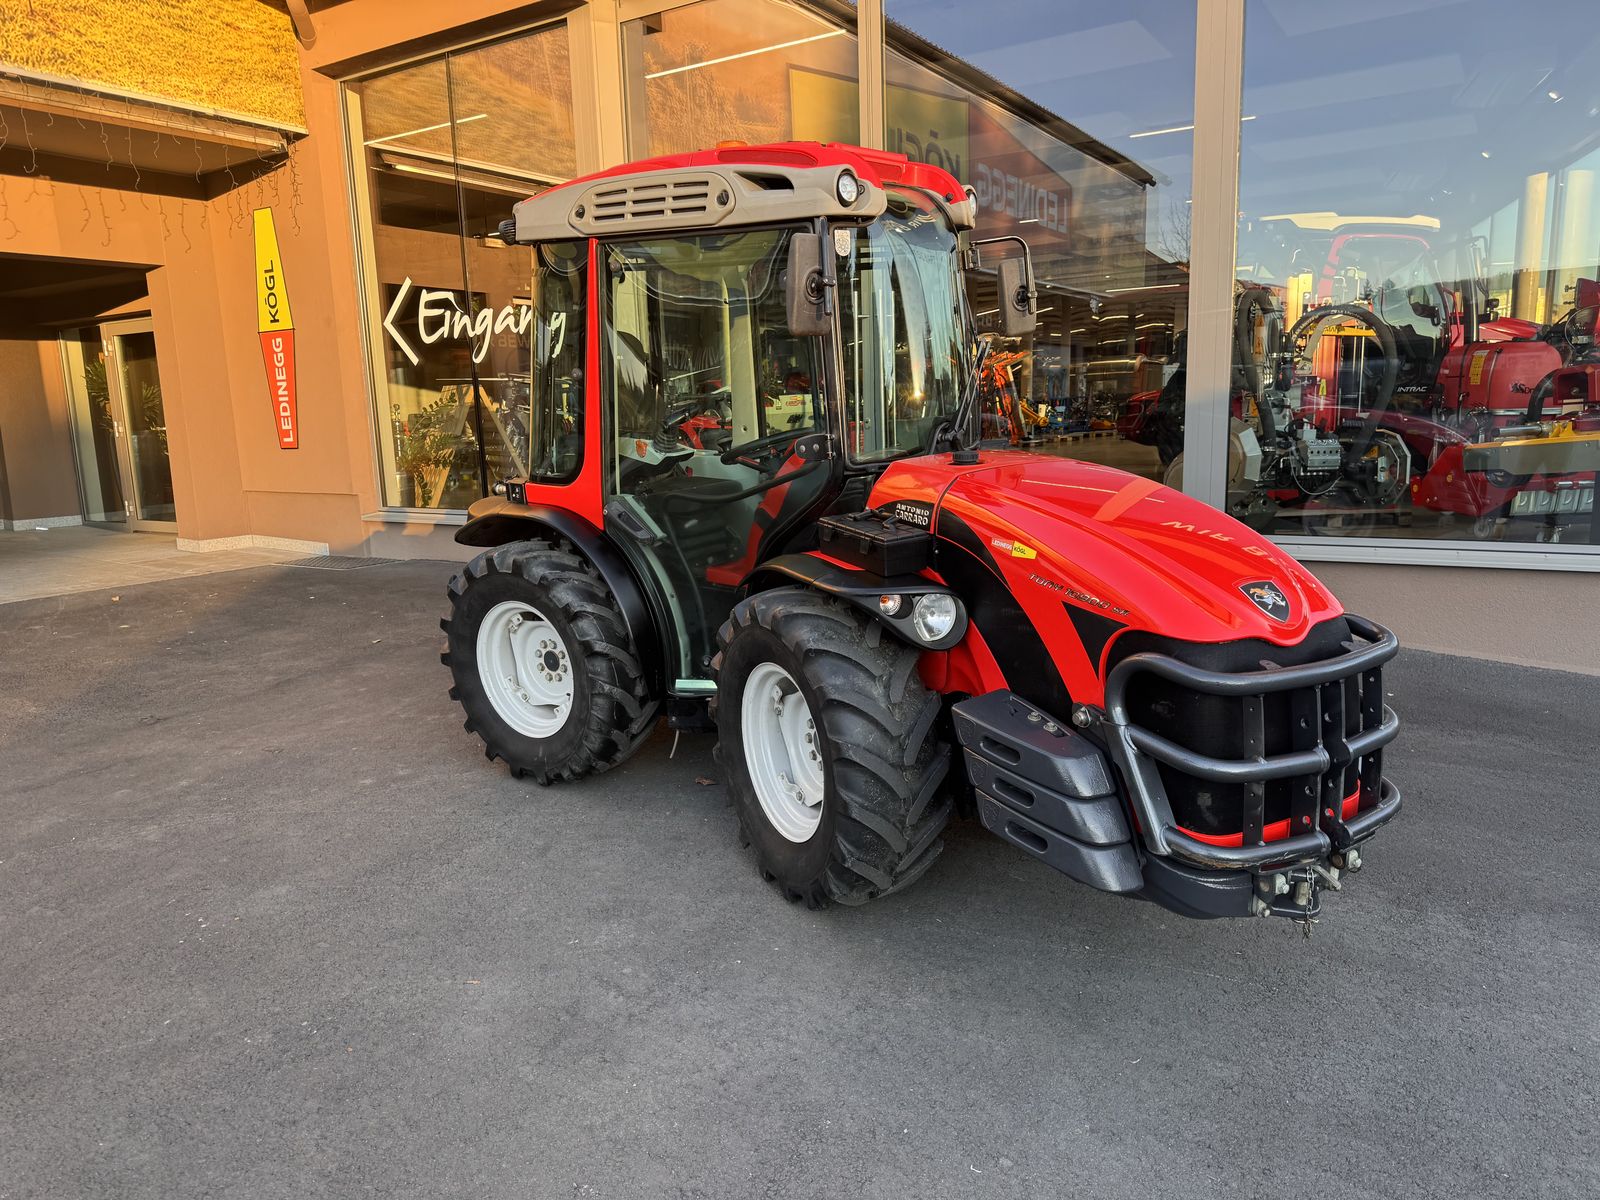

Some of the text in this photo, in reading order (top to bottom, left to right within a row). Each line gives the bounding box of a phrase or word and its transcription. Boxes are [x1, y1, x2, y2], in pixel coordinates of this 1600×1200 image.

[418, 288, 567, 364] Eingang
[264, 259, 294, 442] LEDINEGG KÖGL
[895, 509, 929, 526] CARRARO
[896, 503, 930, 516] ANTONIO
[1028, 573, 1064, 591] TONY
